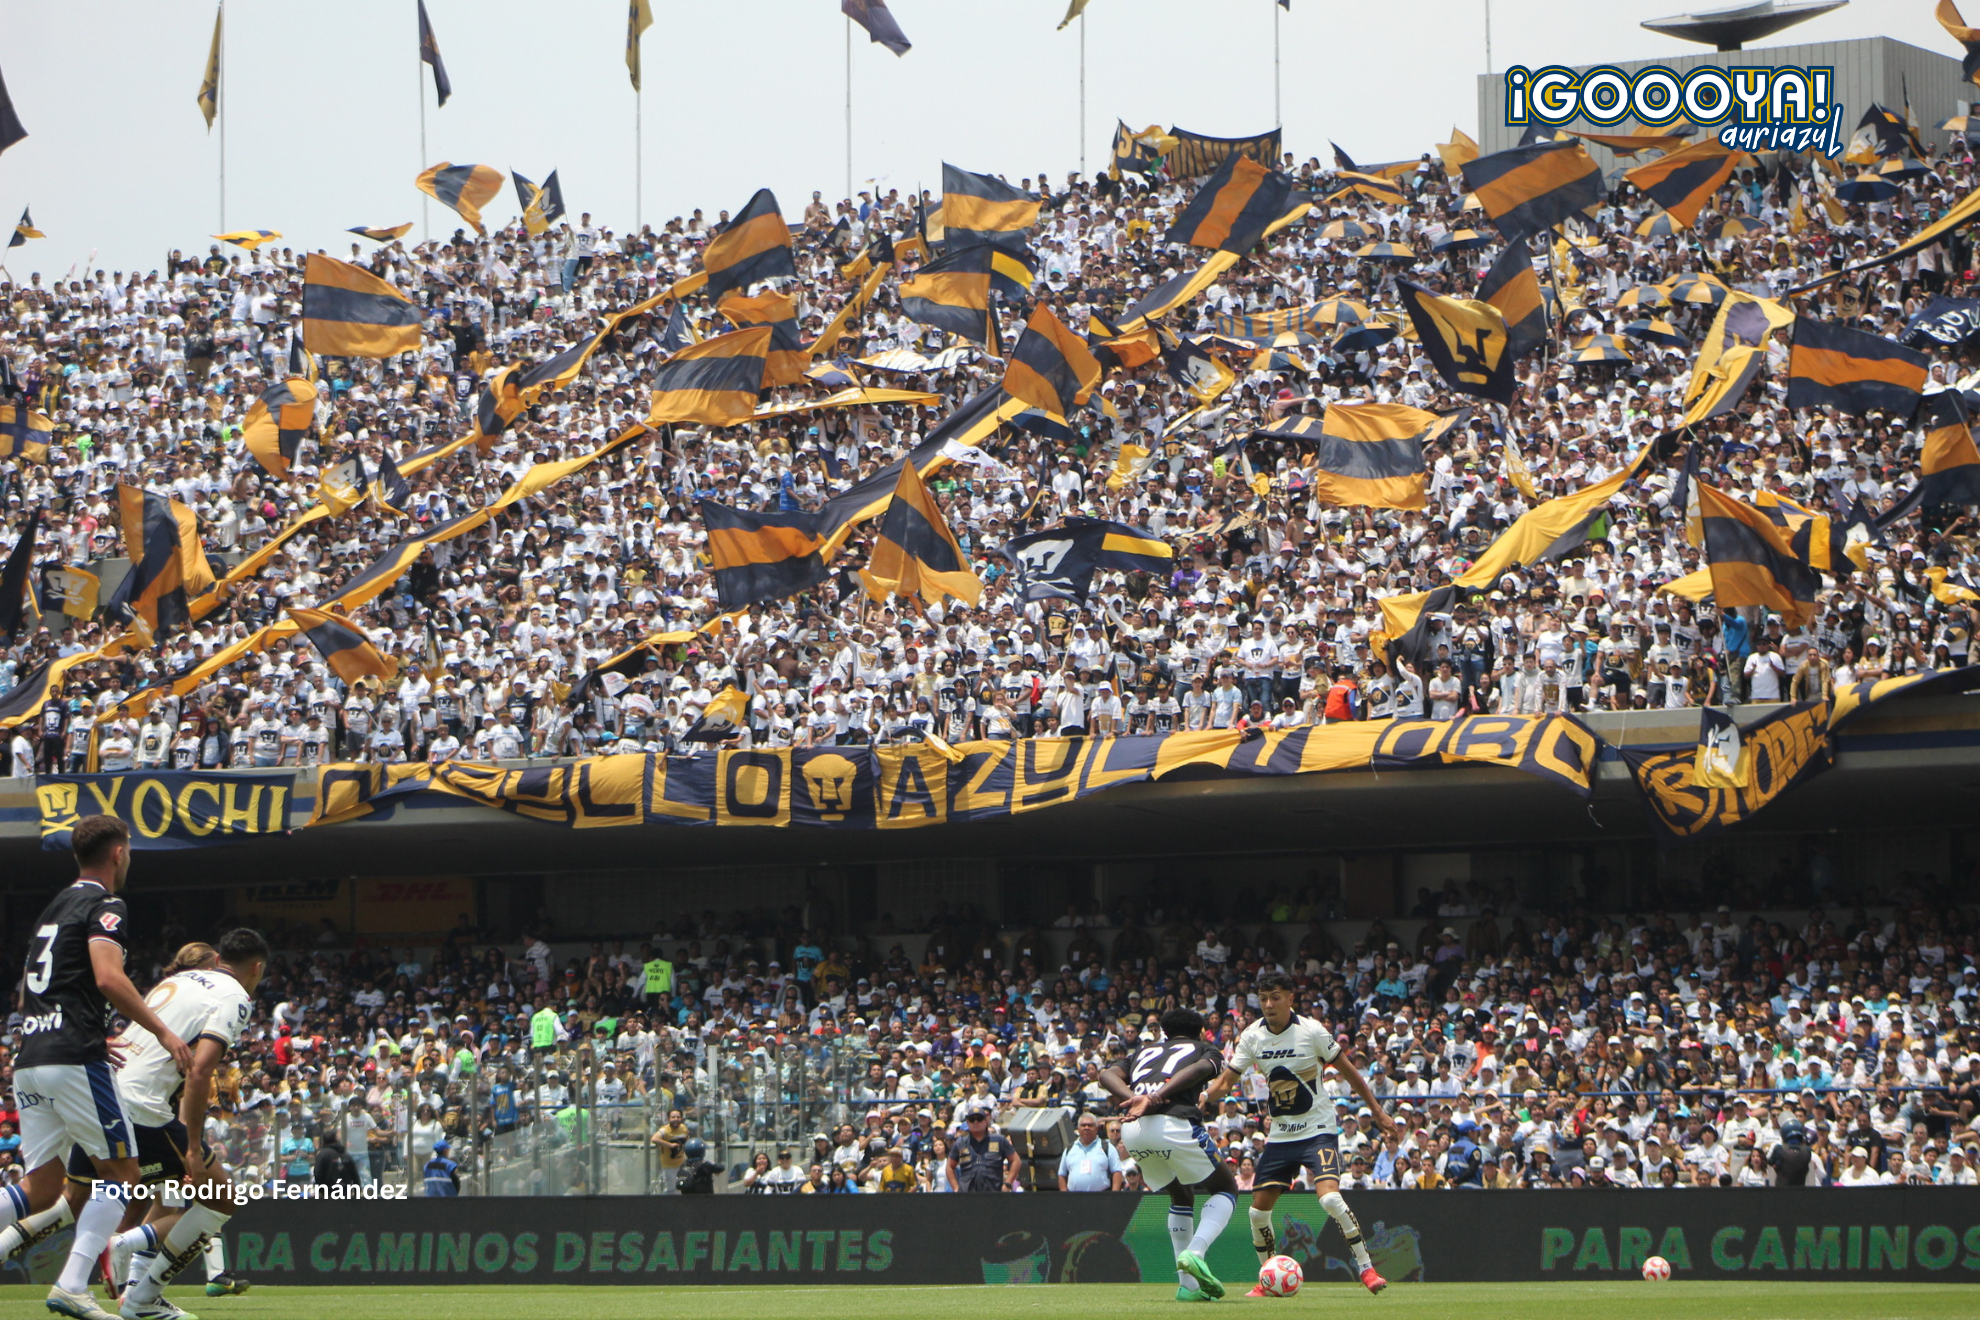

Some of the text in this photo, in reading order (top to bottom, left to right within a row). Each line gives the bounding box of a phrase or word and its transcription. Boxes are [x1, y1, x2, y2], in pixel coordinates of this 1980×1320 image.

[87, 776, 288, 839] XOCHI
[377, 882, 453, 901] DHL
[27, 924, 59, 994] 3
[175, 972, 215, 990] ZUKI
[1132, 1043, 1196, 1082] 27
[1261, 1049, 1296, 1059] DHL
[1134, 1081, 1166, 1096] ow
[1287, 1122, 1307, 1132] Mifel
[1317, 1149, 1335, 1166] 17
[203, 1229, 894, 1272] RA CAMINOS DESAFIANTES
[1541, 1225, 1980, 1270] PARA CAMINOS
